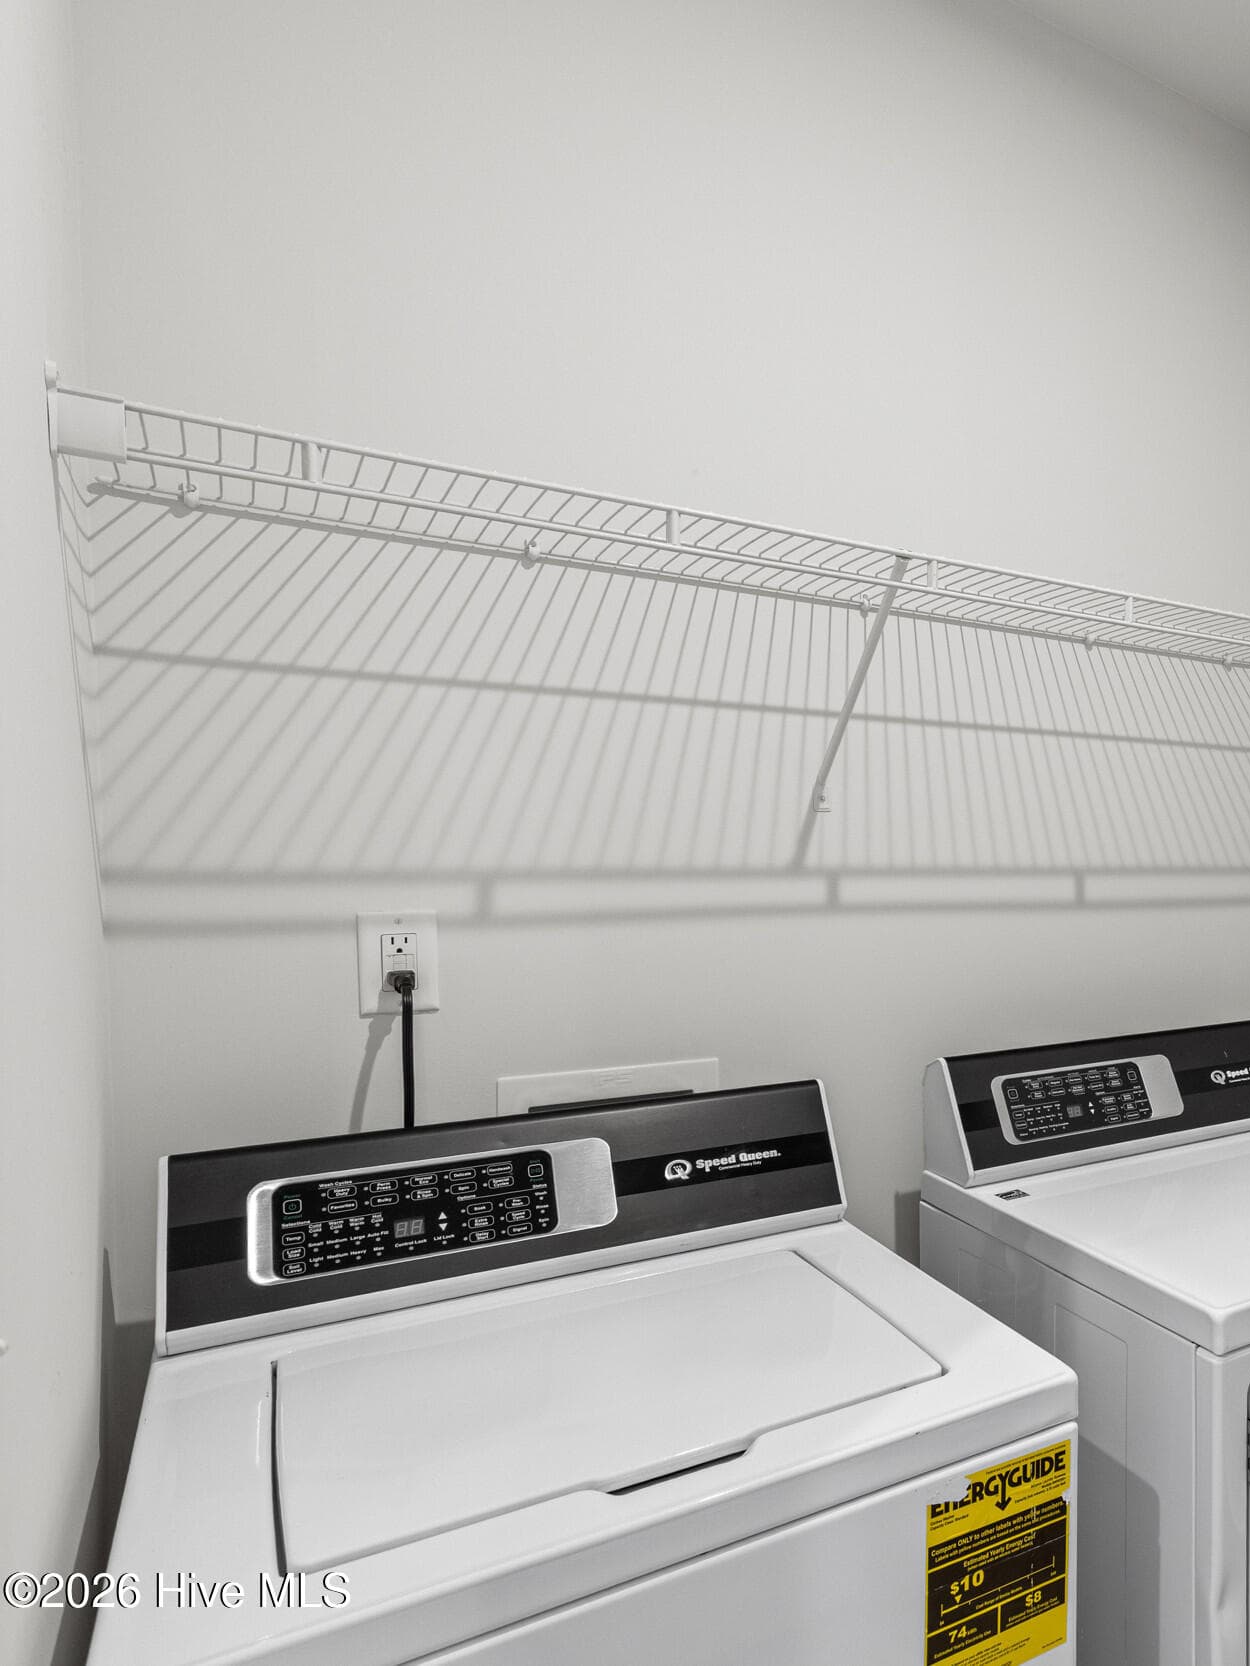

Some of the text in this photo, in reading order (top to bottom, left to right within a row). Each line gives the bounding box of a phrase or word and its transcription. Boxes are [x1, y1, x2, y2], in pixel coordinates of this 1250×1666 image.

[696, 1154, 737, 1173] Speed
[931, 1542, 957, 1557] Compare
[957, 1534, 973, 1547] ONLY
[950, 1569, 985, 1596] $10
[1025, 1590, 1042, 1608] $8
[948, 1624, 967, 1644] 74
